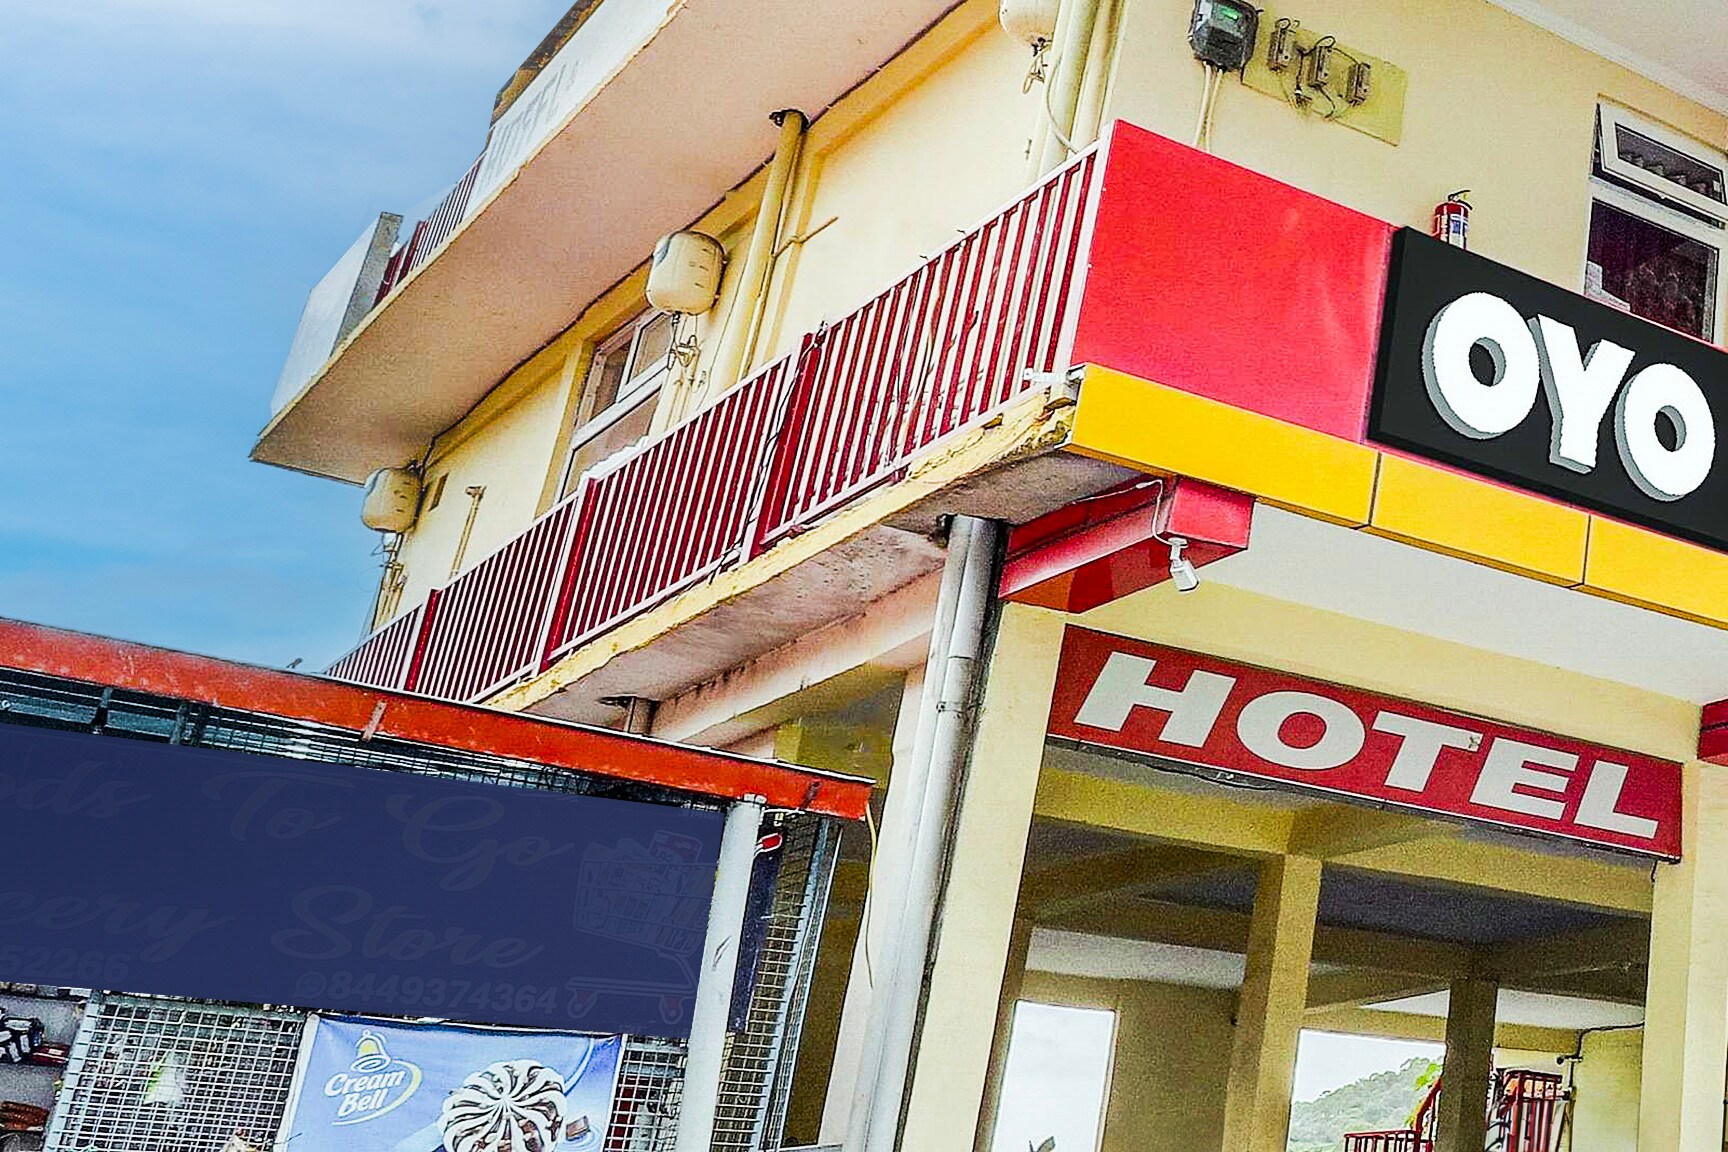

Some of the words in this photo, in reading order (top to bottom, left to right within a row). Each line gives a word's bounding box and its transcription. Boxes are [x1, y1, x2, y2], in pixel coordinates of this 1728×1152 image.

[1422, 291, 1716, 502] OYO
[1073, 651, 1659, 840] HOTEL
[324, 1069, 408, 1094] Cream
[338, 1088, 389, 1117] Bell
